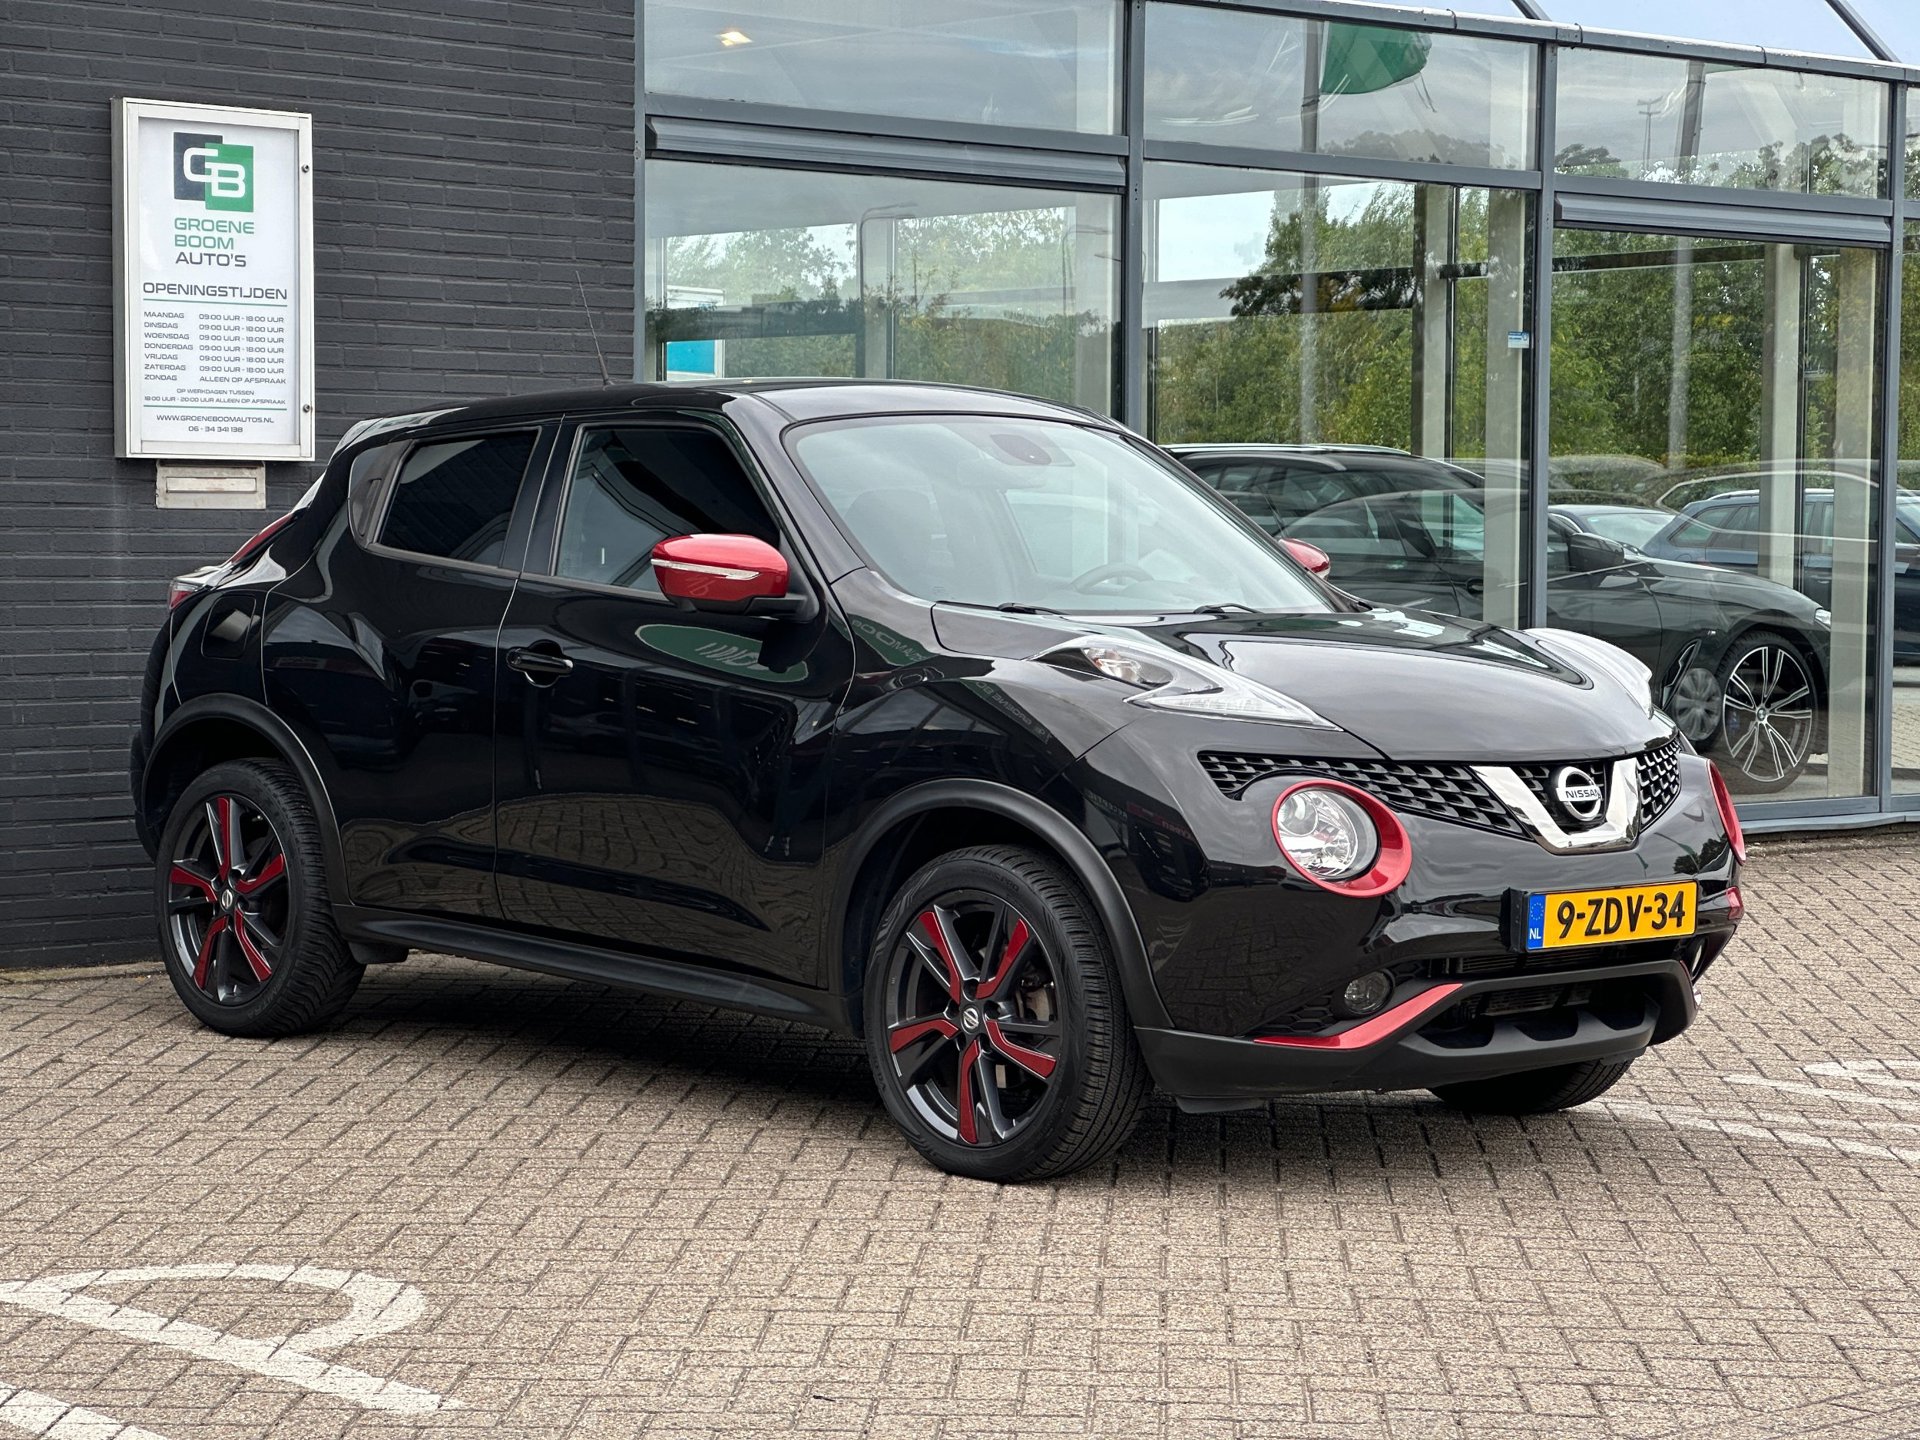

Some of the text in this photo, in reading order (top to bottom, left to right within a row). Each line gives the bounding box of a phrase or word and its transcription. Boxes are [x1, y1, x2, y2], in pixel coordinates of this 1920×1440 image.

[174, 217, 255, 234] GROENE
[174, 235, 234, 250] BOOM
[175, 252, 247, 267] AUTO'S
[142, 282, 288, 300] OPENINGSTIJDEN
[144, 311, 185, 319] MAANDAG
[144, 321, 179, 329] DINSDAG
[144, 332, 190, 340] WOENSDAG
[144, 342, 194, 351] DONDERDAG
[144, 353, 179, 361] VRIJDAG
[144, 363, 187, 371] ZATERDAG
[144, 374, 178, 382] ZONDAG
[1556, 890, 1686, 940] 9-ZDV-34
[1529, 927, 1542, 940] NL
